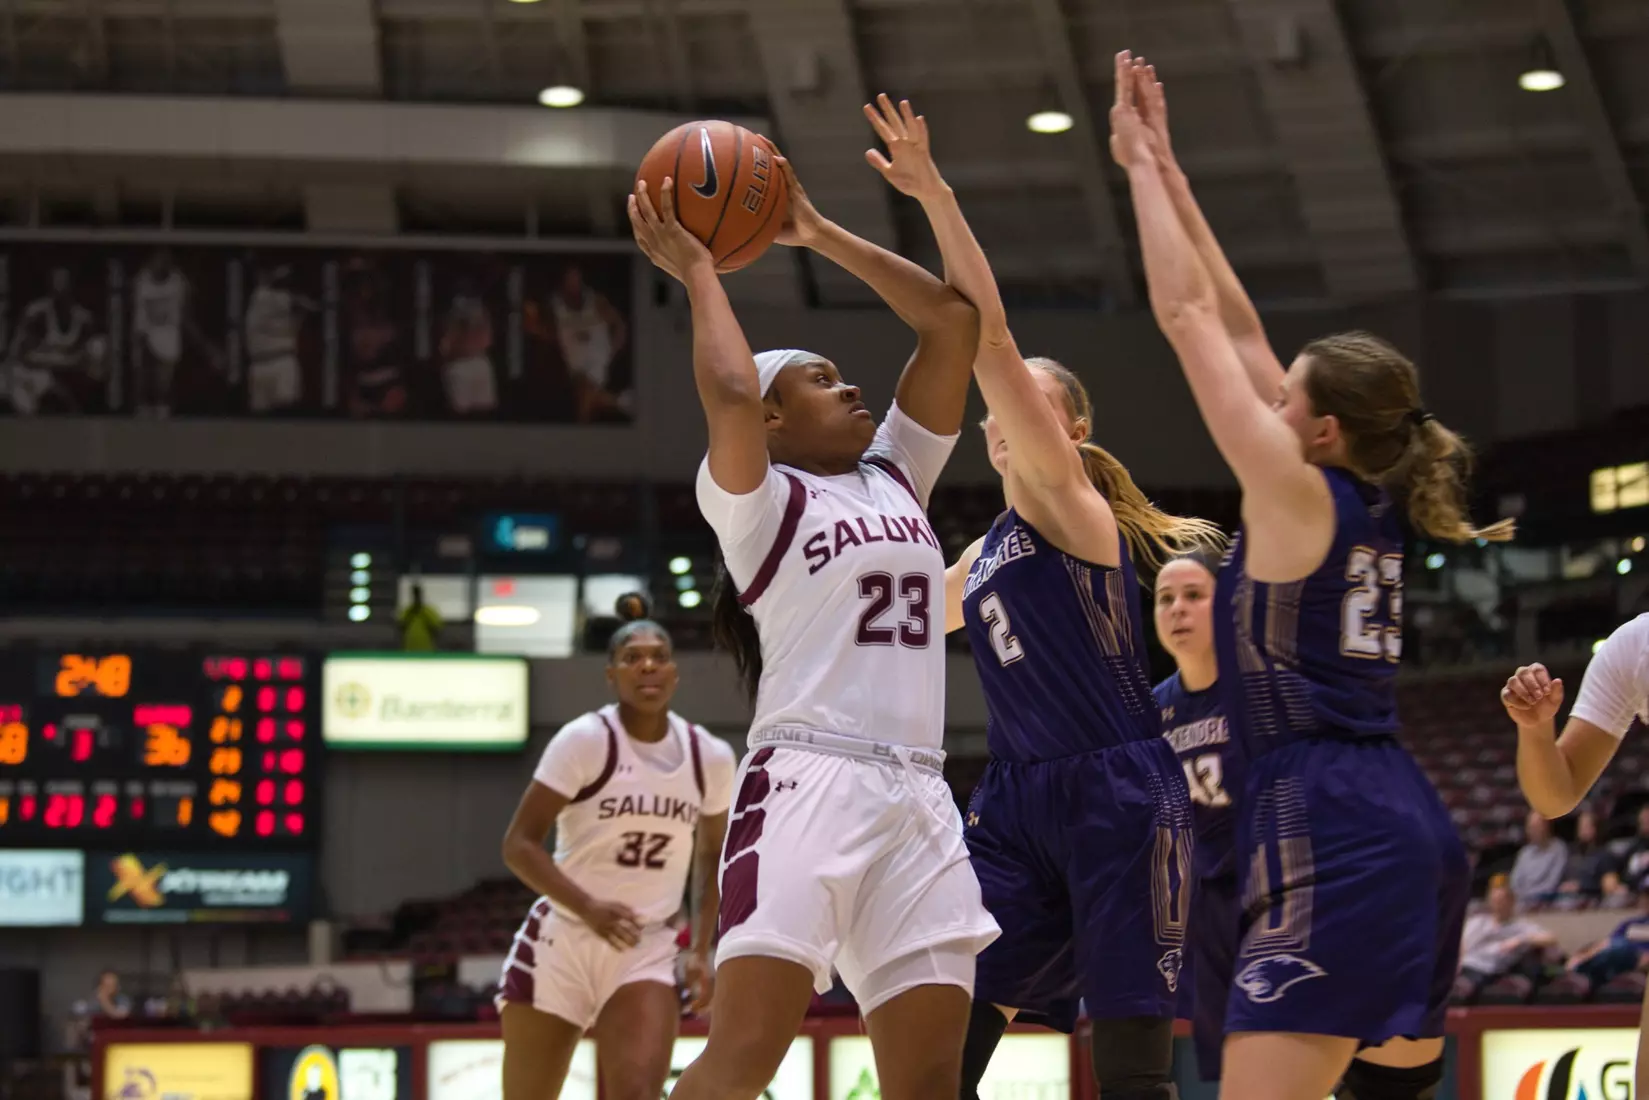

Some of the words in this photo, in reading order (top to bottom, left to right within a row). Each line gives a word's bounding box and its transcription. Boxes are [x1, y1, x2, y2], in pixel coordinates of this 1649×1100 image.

[741, 144, 772, 216] ELITE
[855, 571, 930, 649] 23
[979, 592, 1024, 667] 2
[616, 830, 674, 870] 32
